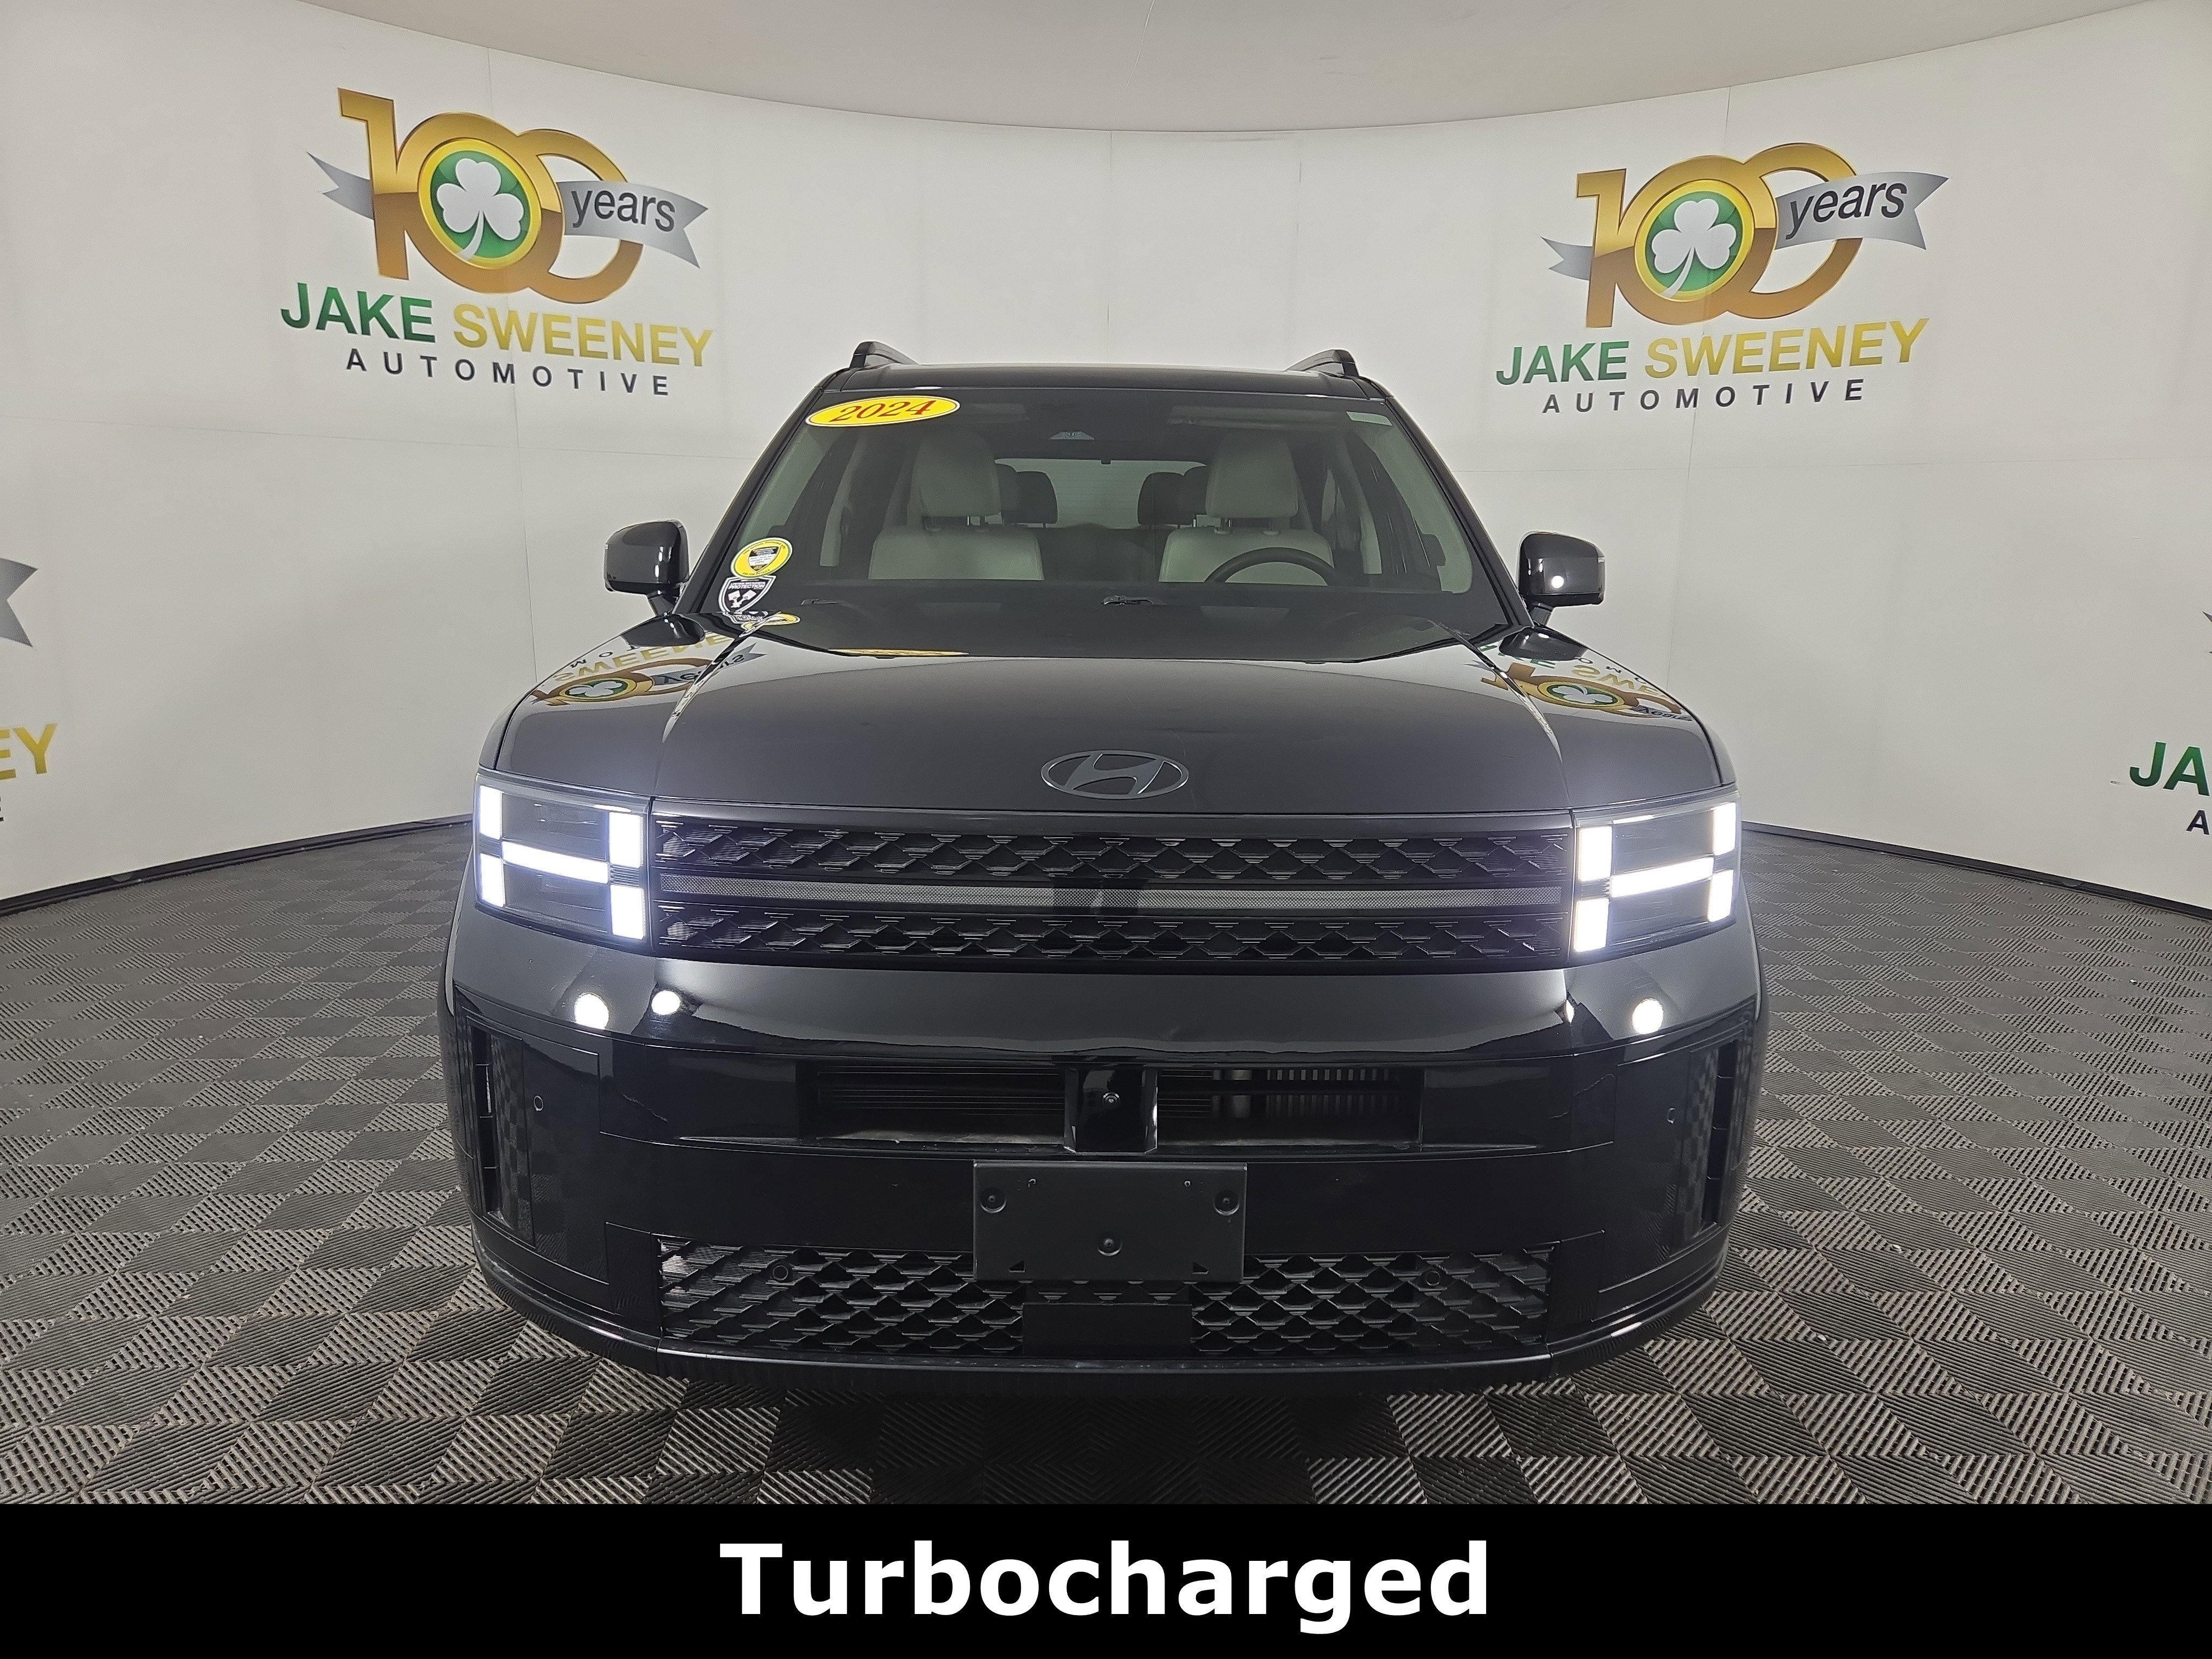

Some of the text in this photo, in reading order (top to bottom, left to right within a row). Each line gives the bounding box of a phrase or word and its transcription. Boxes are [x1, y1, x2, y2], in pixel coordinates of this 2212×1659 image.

[337, 87, 677, 304] 100 years
[1576, 142, 1908, 329] 100 years
[280, 282, 715, 367] JAKE SWEENEY
[1495, 317, 1930, 385] JAKE SWEENEY
[346, 348, 670, 396] AUTOMOTIVE
[1542, 378, 1865, 414] AUTOMOTIVE
[829, 400, 937, 422] 2024
[2129, 741, 2210, 797] JA
